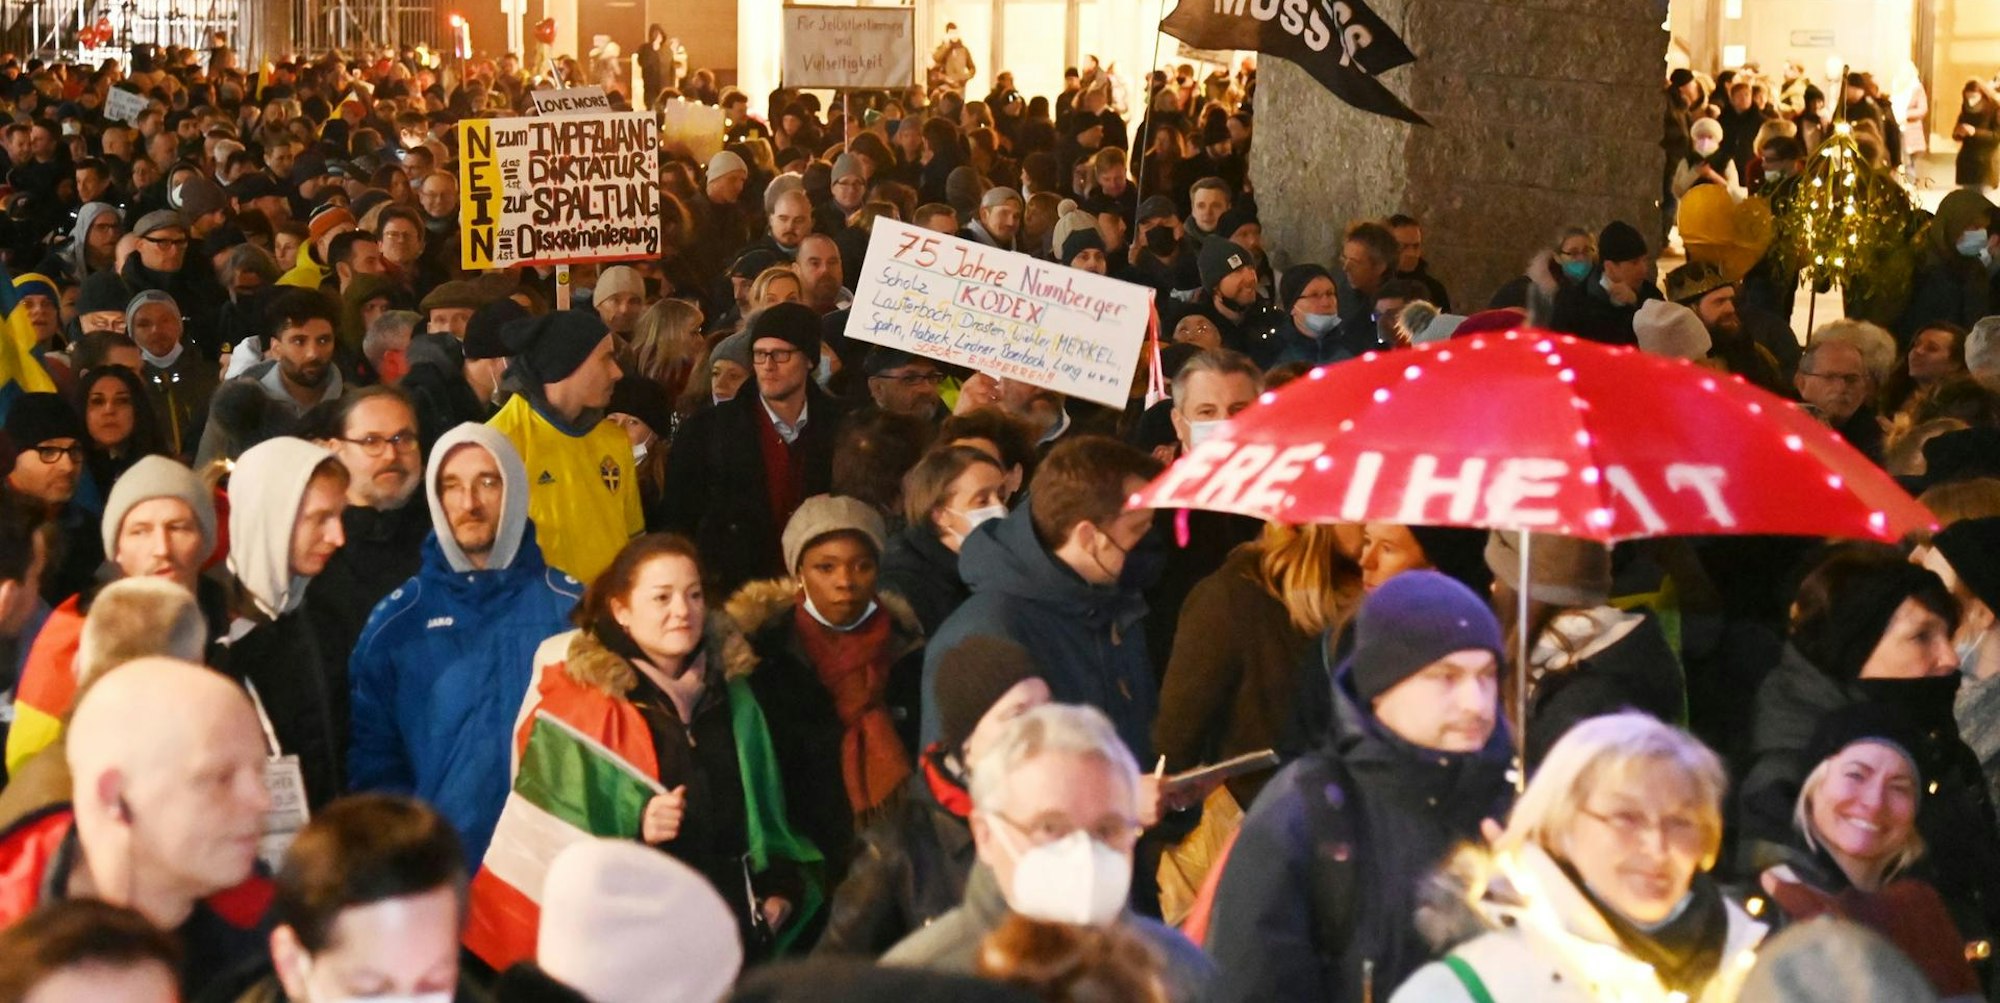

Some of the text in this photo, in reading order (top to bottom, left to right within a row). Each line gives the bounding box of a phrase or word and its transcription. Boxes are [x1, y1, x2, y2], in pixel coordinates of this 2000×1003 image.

[537, 95, 608, 114] LOVE MORE
[495, 129, 528, 148] zum
[501, 158, 521, 168] das
[467, 125, 494, 263] NEIN
[506, 180, 521, 189] ist
[502, 181, 660, 224] zur SPALTUNG
[496, 227, 515, 237] das
[497, 250, 514, 260] ist
[893, 230, 943, 267] 75
[943, 245, 1008, 288] Jahre
[959, 284, 1045, 325] KODEX
[1154, 441, 1736, 534] FREIHEIT
